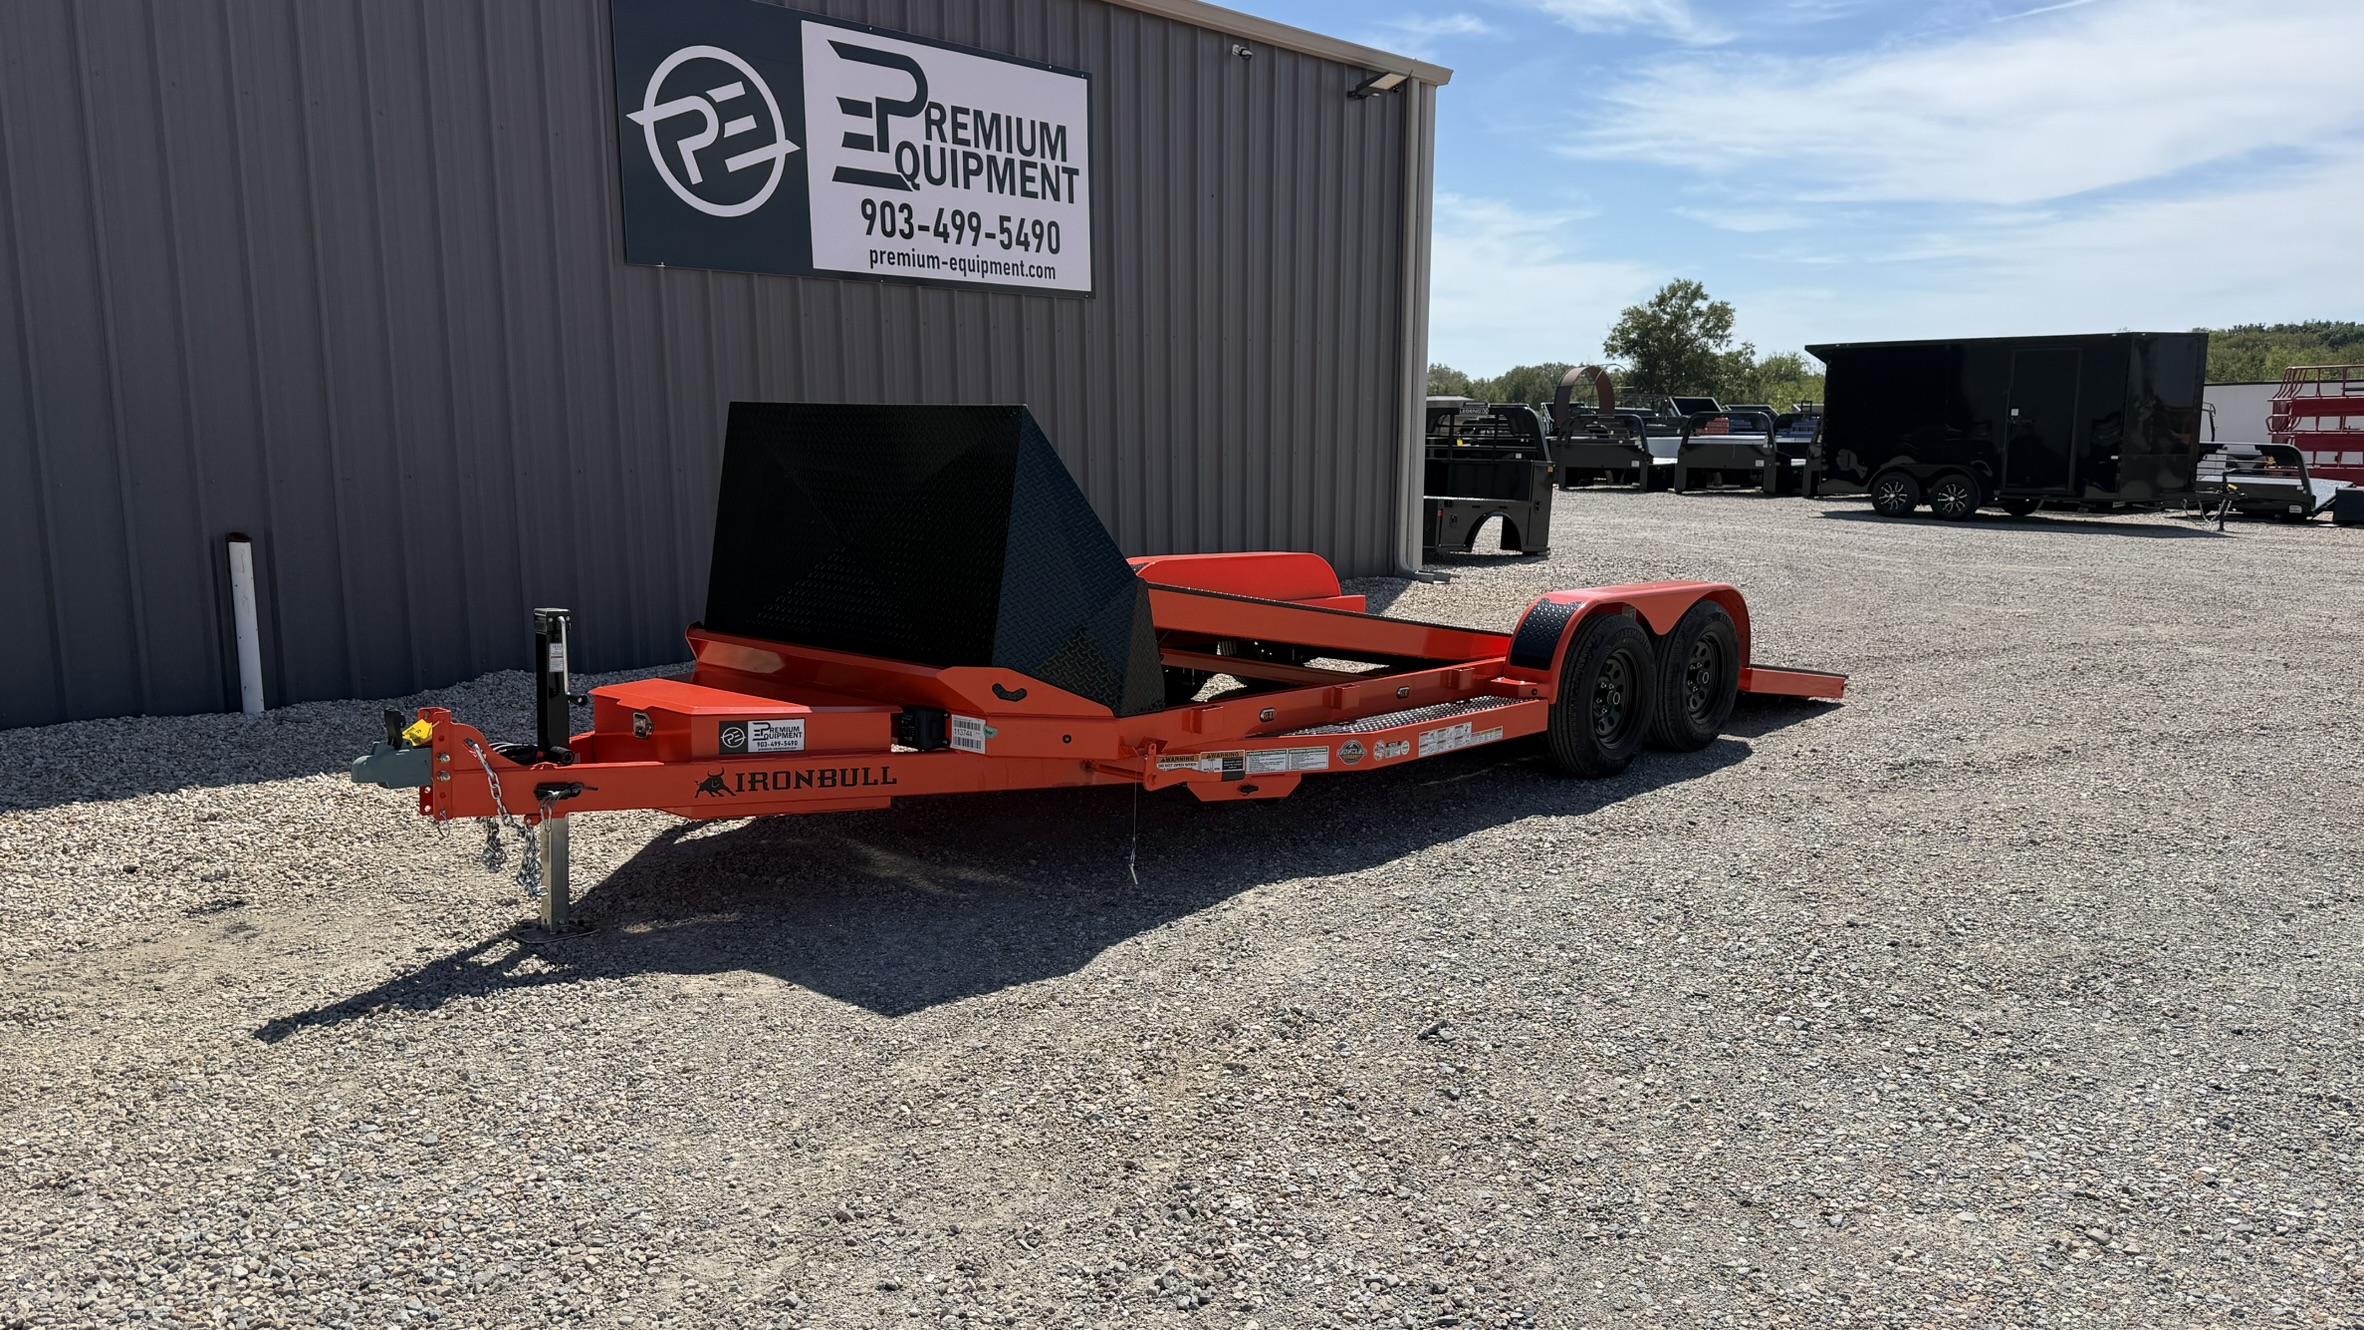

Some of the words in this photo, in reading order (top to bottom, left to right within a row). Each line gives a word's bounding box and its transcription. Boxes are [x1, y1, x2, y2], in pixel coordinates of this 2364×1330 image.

[861, 198, 1061, 255] 903-499-5490
[869, 247, 1056, 280] premium-equipment.com
[756, 740, 798, 748] 903-499-5490
[953, 728, 973, 738] 113744
[735, 766, 898, 793] IRONBULL
